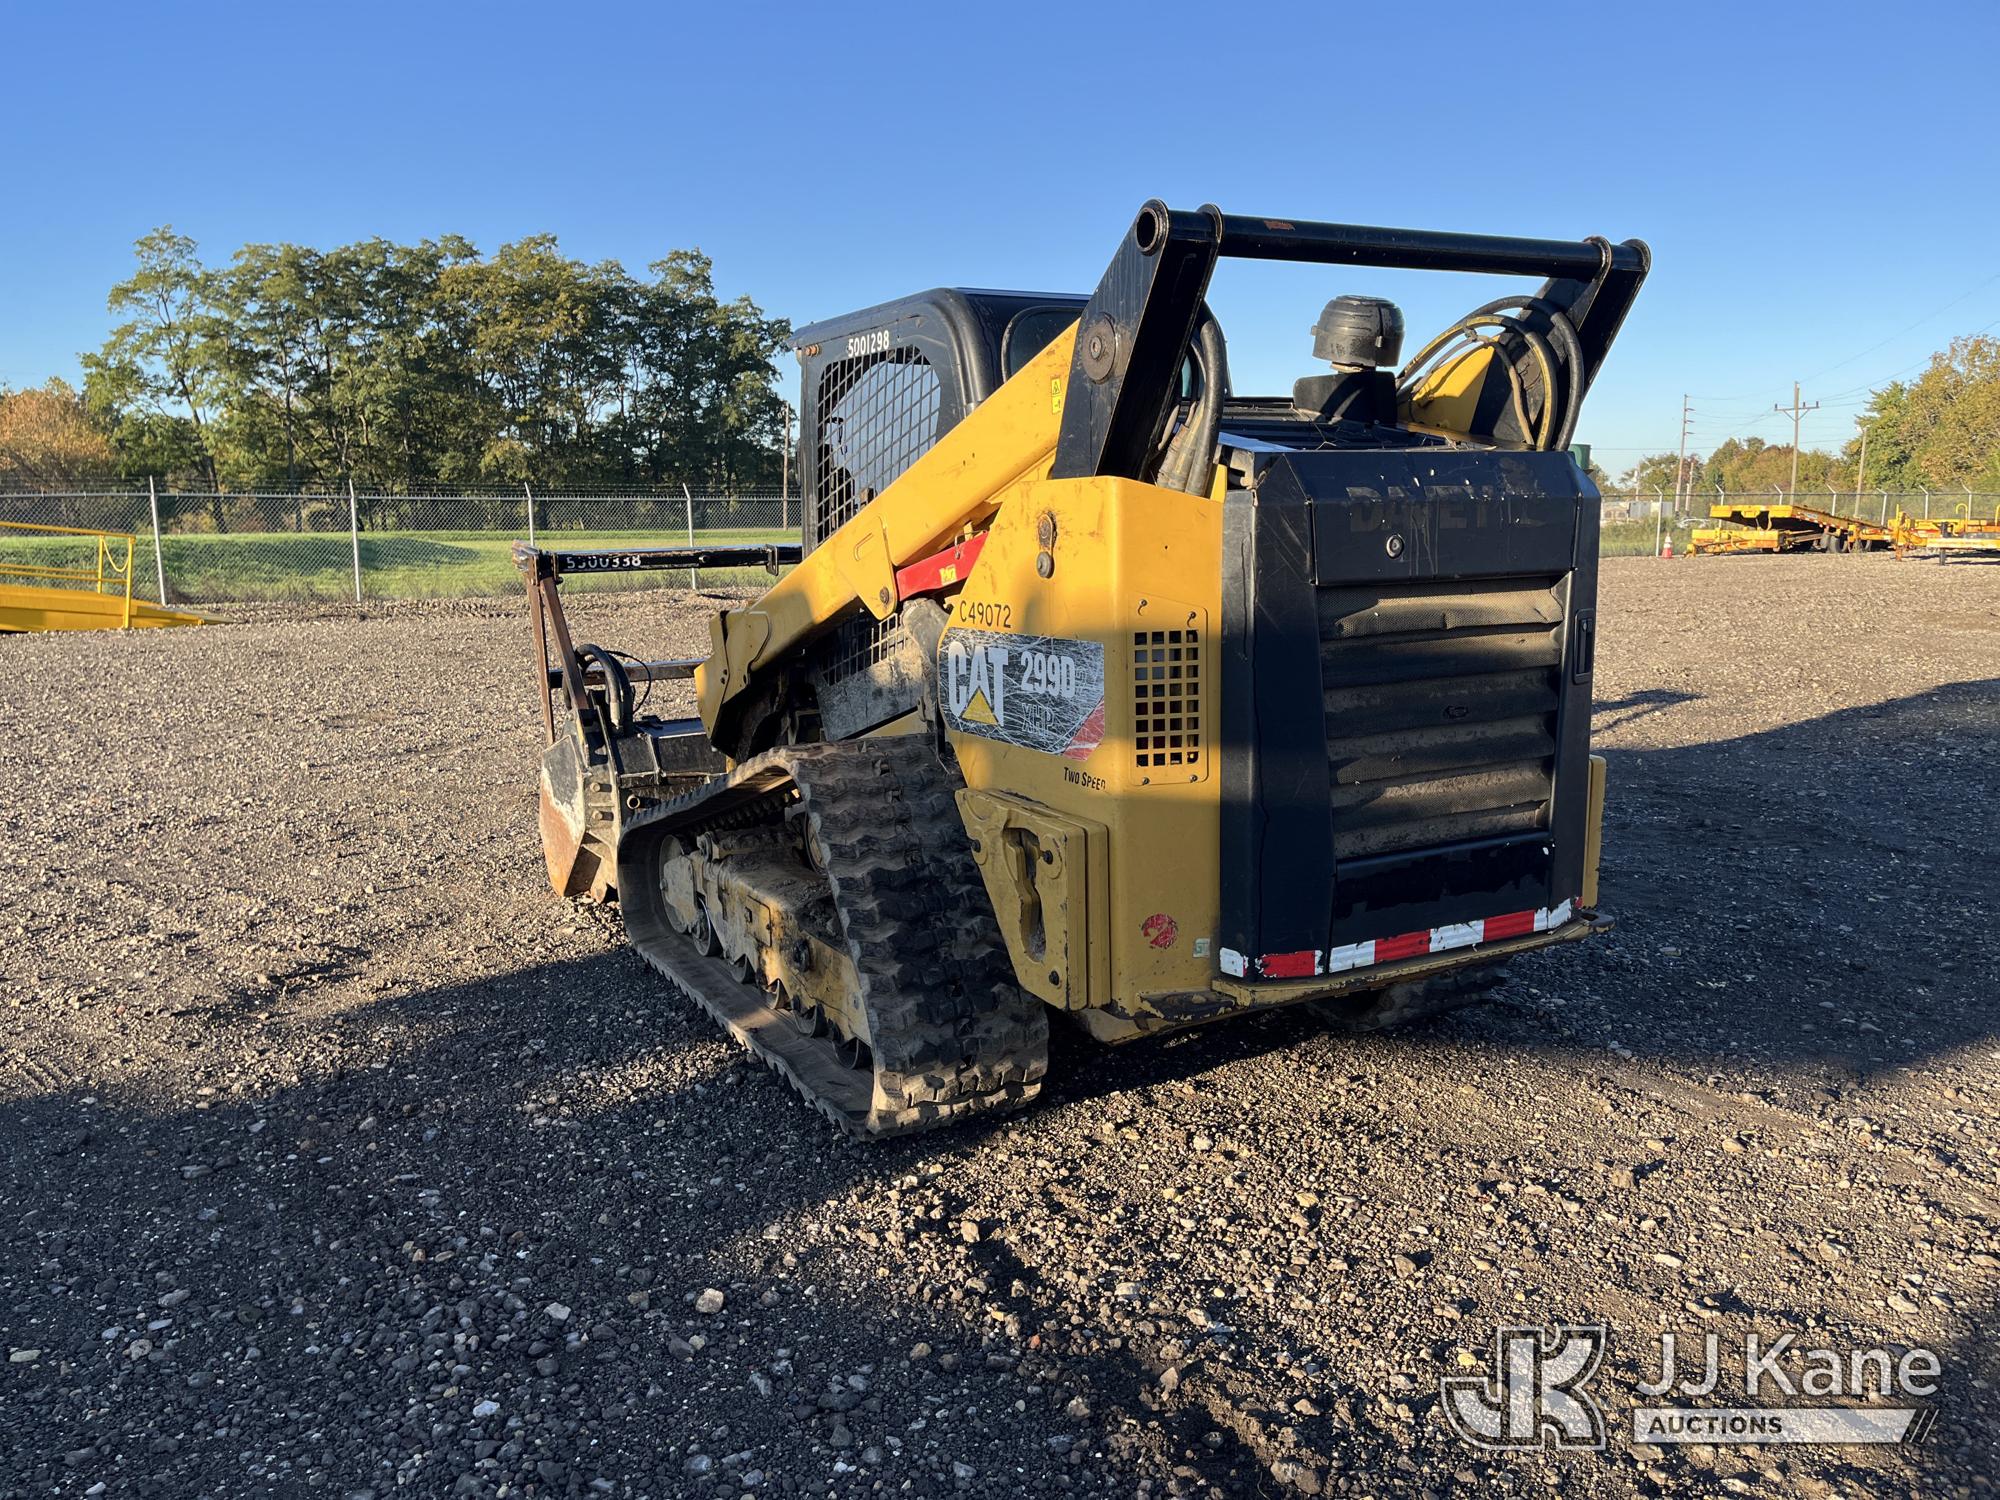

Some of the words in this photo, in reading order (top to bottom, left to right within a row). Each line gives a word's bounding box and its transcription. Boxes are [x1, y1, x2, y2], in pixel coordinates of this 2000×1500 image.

[848, 330, 889, 358] 5001298
[960, 600, 1012, 629] C49072
[949, 641, 1009, 727] CAT
[1021, 702, 1055, 736] XHP
